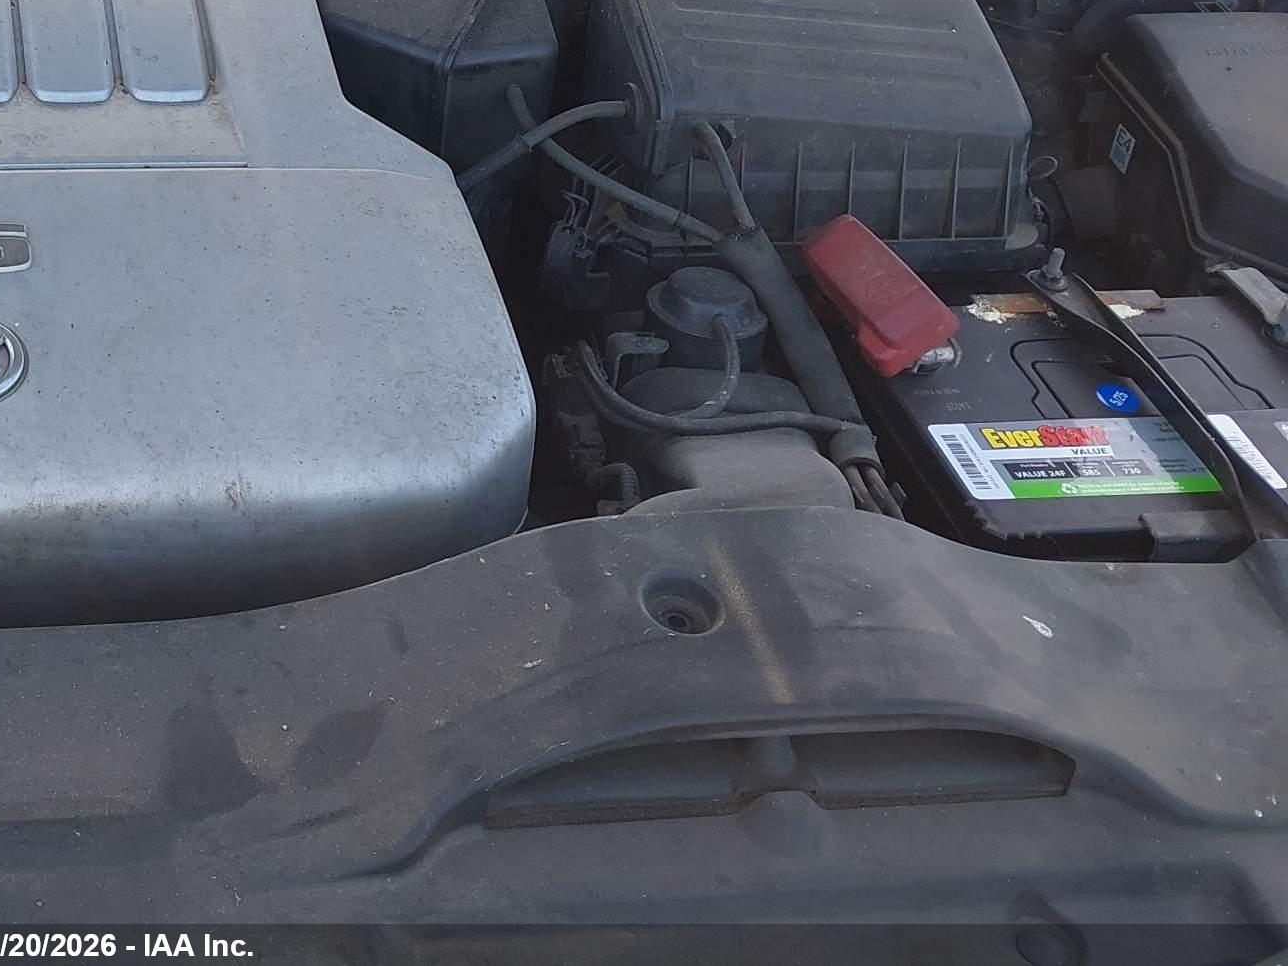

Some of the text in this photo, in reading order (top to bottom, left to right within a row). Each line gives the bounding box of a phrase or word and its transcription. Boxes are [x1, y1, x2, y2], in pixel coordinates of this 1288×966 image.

[980, 424, 1111, 449] EverStart
[1071, 447, 1109, 456] VALUE
[1014, 470, 1048, 479] VALUE
